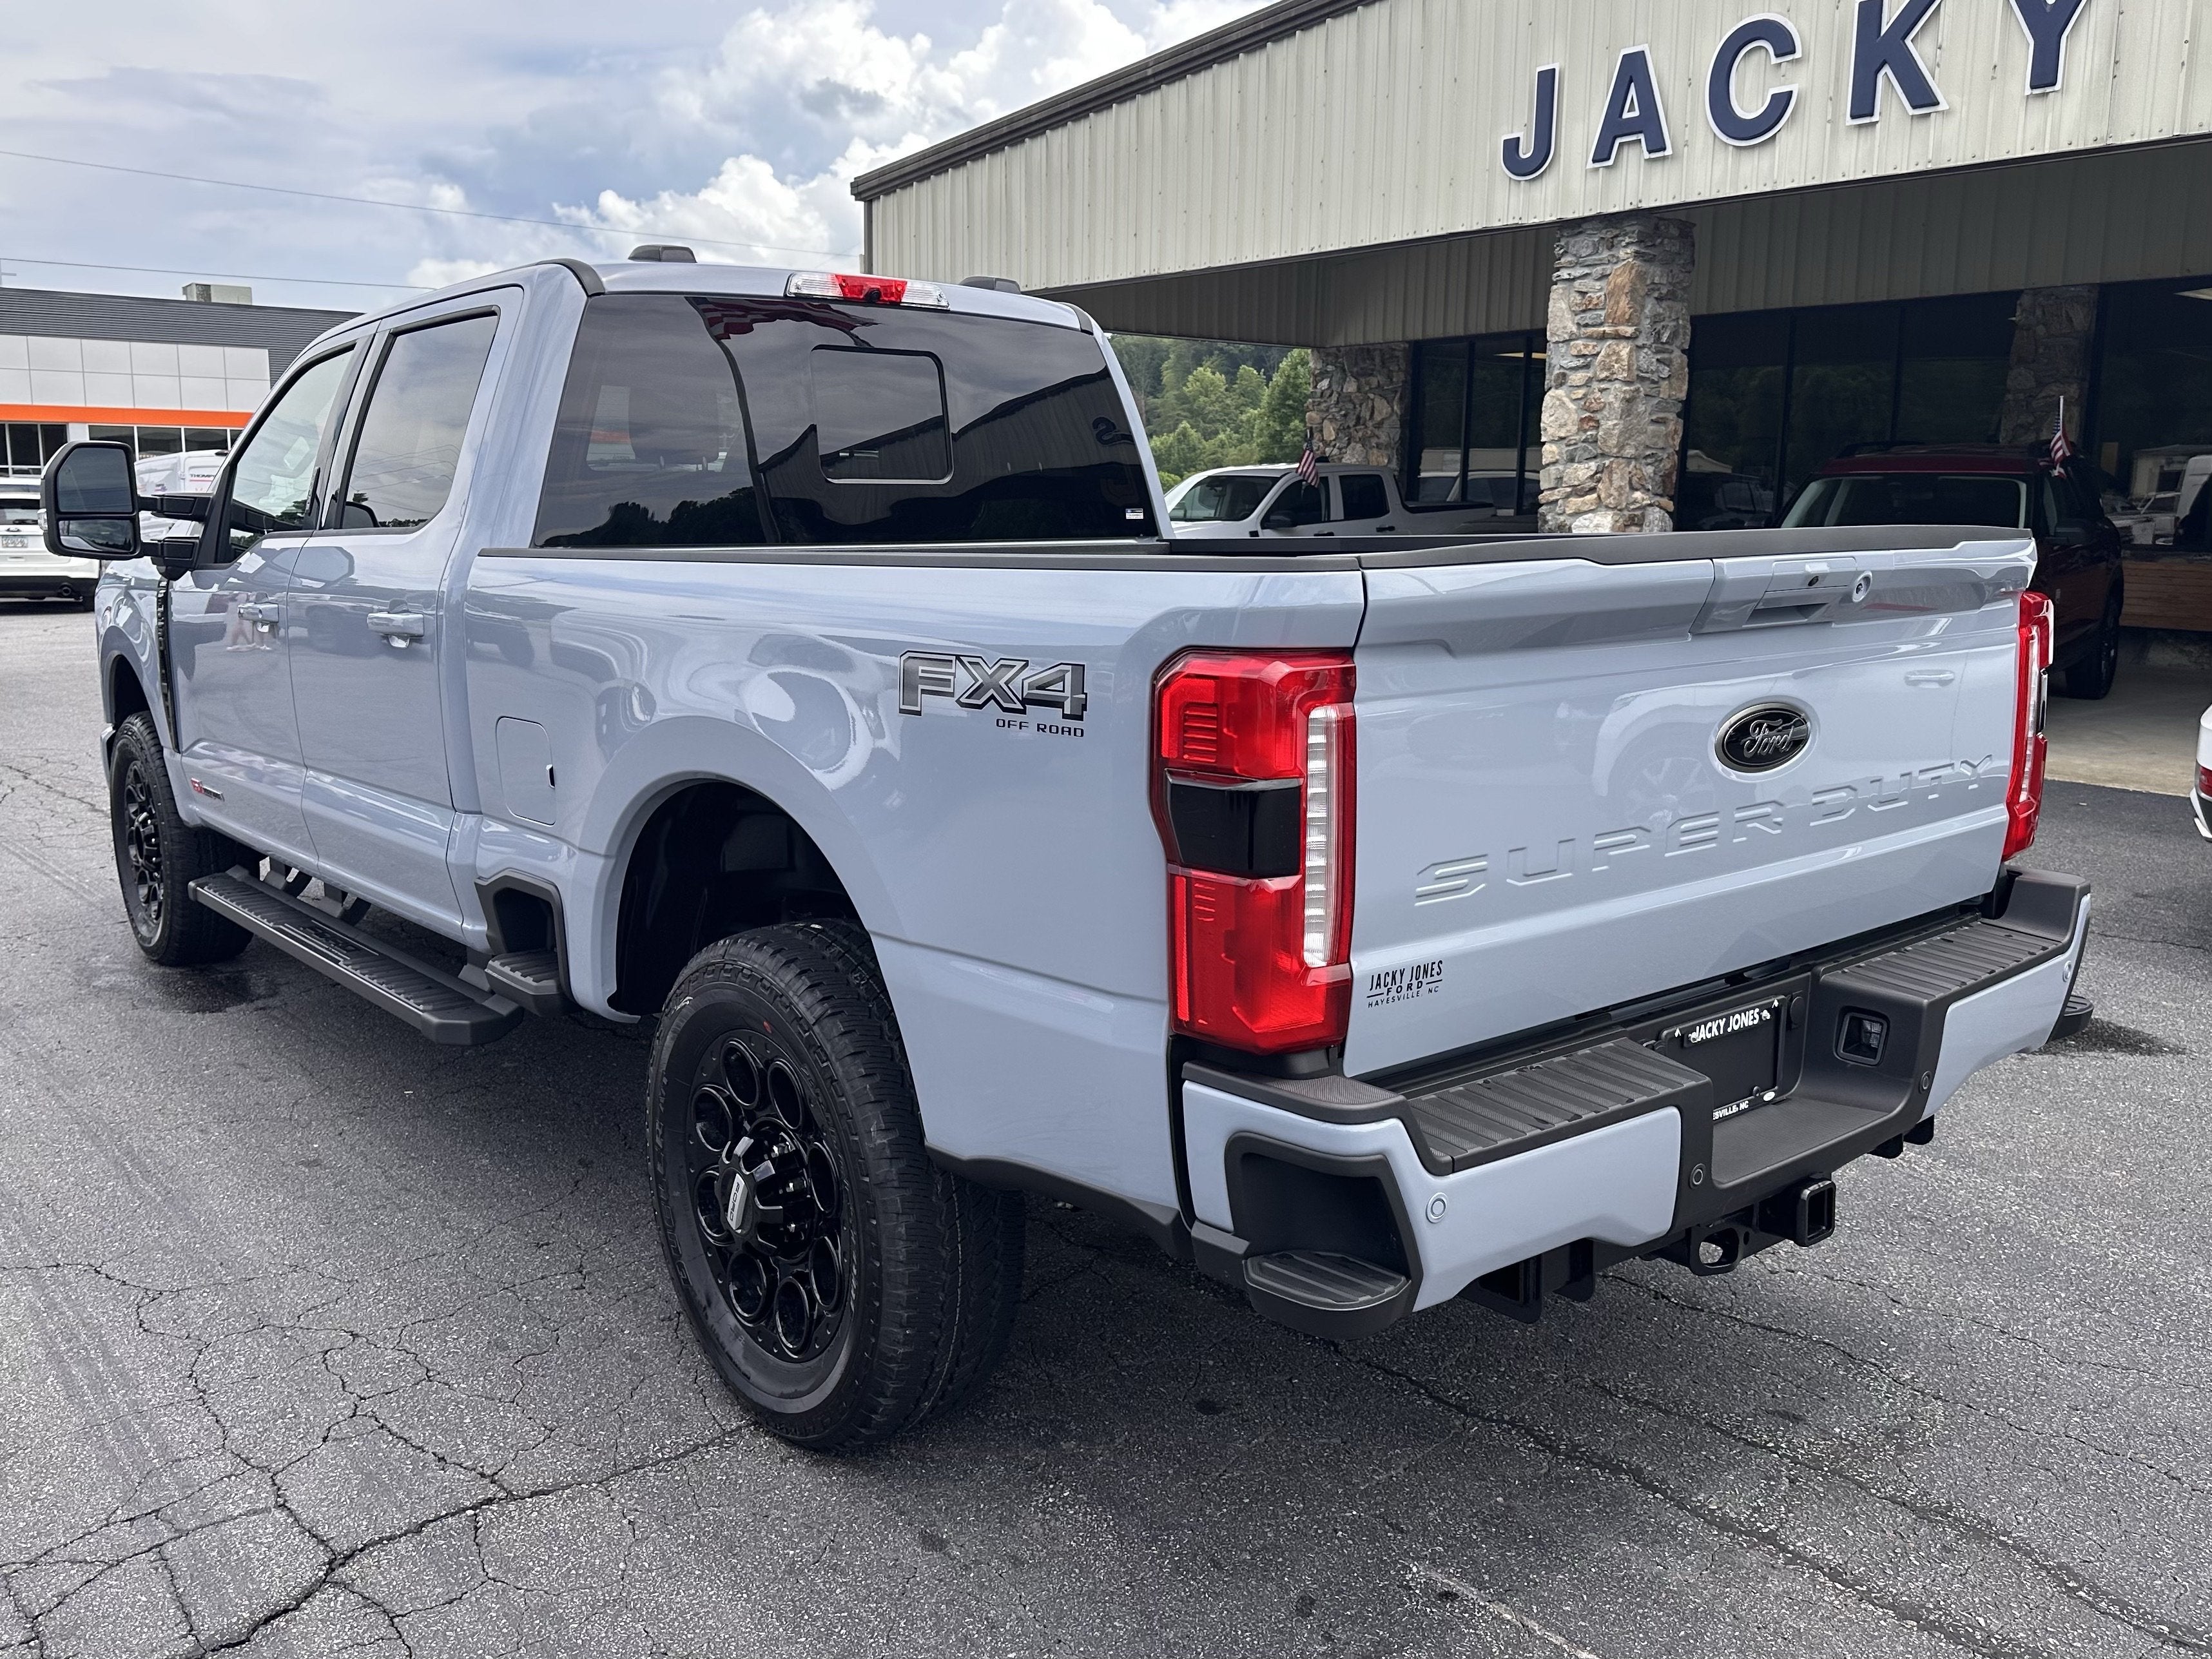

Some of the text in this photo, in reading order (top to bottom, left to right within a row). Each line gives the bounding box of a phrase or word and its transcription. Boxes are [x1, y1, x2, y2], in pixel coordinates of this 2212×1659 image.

[1500, 0, 2086, 181] JACKY
[898, 650, 1088, 722] FX4
[996, 718, 1084, 737] OFF ROAD
[1741, 718, 1795, 759] Ford
[1414, 753, 1993, 907] SUPER DUTY
[1369, 960, 1443, 991] JACKY JONES
[1386, 980, 1423, 996] FORD
[1428, 985, 1439, 994] NC
[1694, 1007, 1760, 1042] JACKY JONES
[1739, 1100, 1749, 1111] NC
[729, 1181, 740, 1222] FORD
